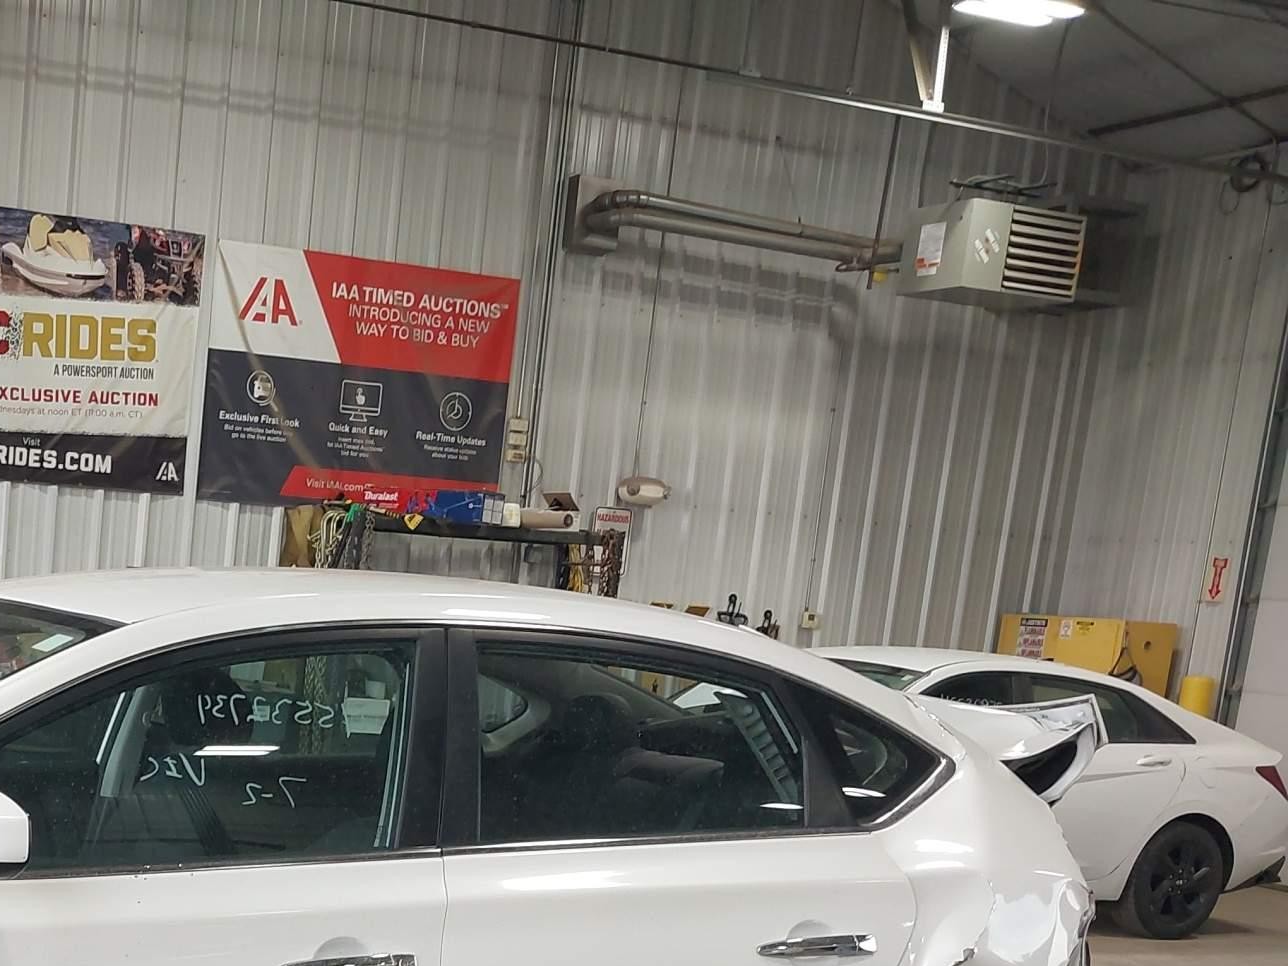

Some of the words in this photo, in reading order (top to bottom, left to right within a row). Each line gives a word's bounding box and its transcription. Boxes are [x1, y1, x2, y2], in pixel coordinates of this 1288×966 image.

[331, 281, 360, 301] IAA
[362, 285, 415, 307] TIMED
[348, 304, 442, 328] INTRODUCING
[444, 315, 455, 330] A
[458, 317, 490, 334] NEW
[355, 321, 388, 338] WAY
[390, 325, 410, 340] TO
[413, 329, 434, 344] BID
[437, 332, 448, 346] &
[451, 333, 479, 348] BUY
[53, 364, 60, 376] A
[62, 364, 118, 379] POWERSPORT
[119, 367, 154, 380] AUCTION
[88, 390, 159, 407] AUCTION
[71, 408, 82, 416] ET
[219, 410, 259, 423] Exclusive
[260, 414, 279, 425] First
[328, 421, 350, 433] Quick
[351, 426, 367, 434] and
[369, 426, 389, 439] Easy
[23, 436, 41, 447] Visit
[416, 430, 456, 443] Real-Time
[457, 434, 487, 447] Updates
[306, 478, 324, 489] Visit
[364, 491, 399, 501] Duralast
